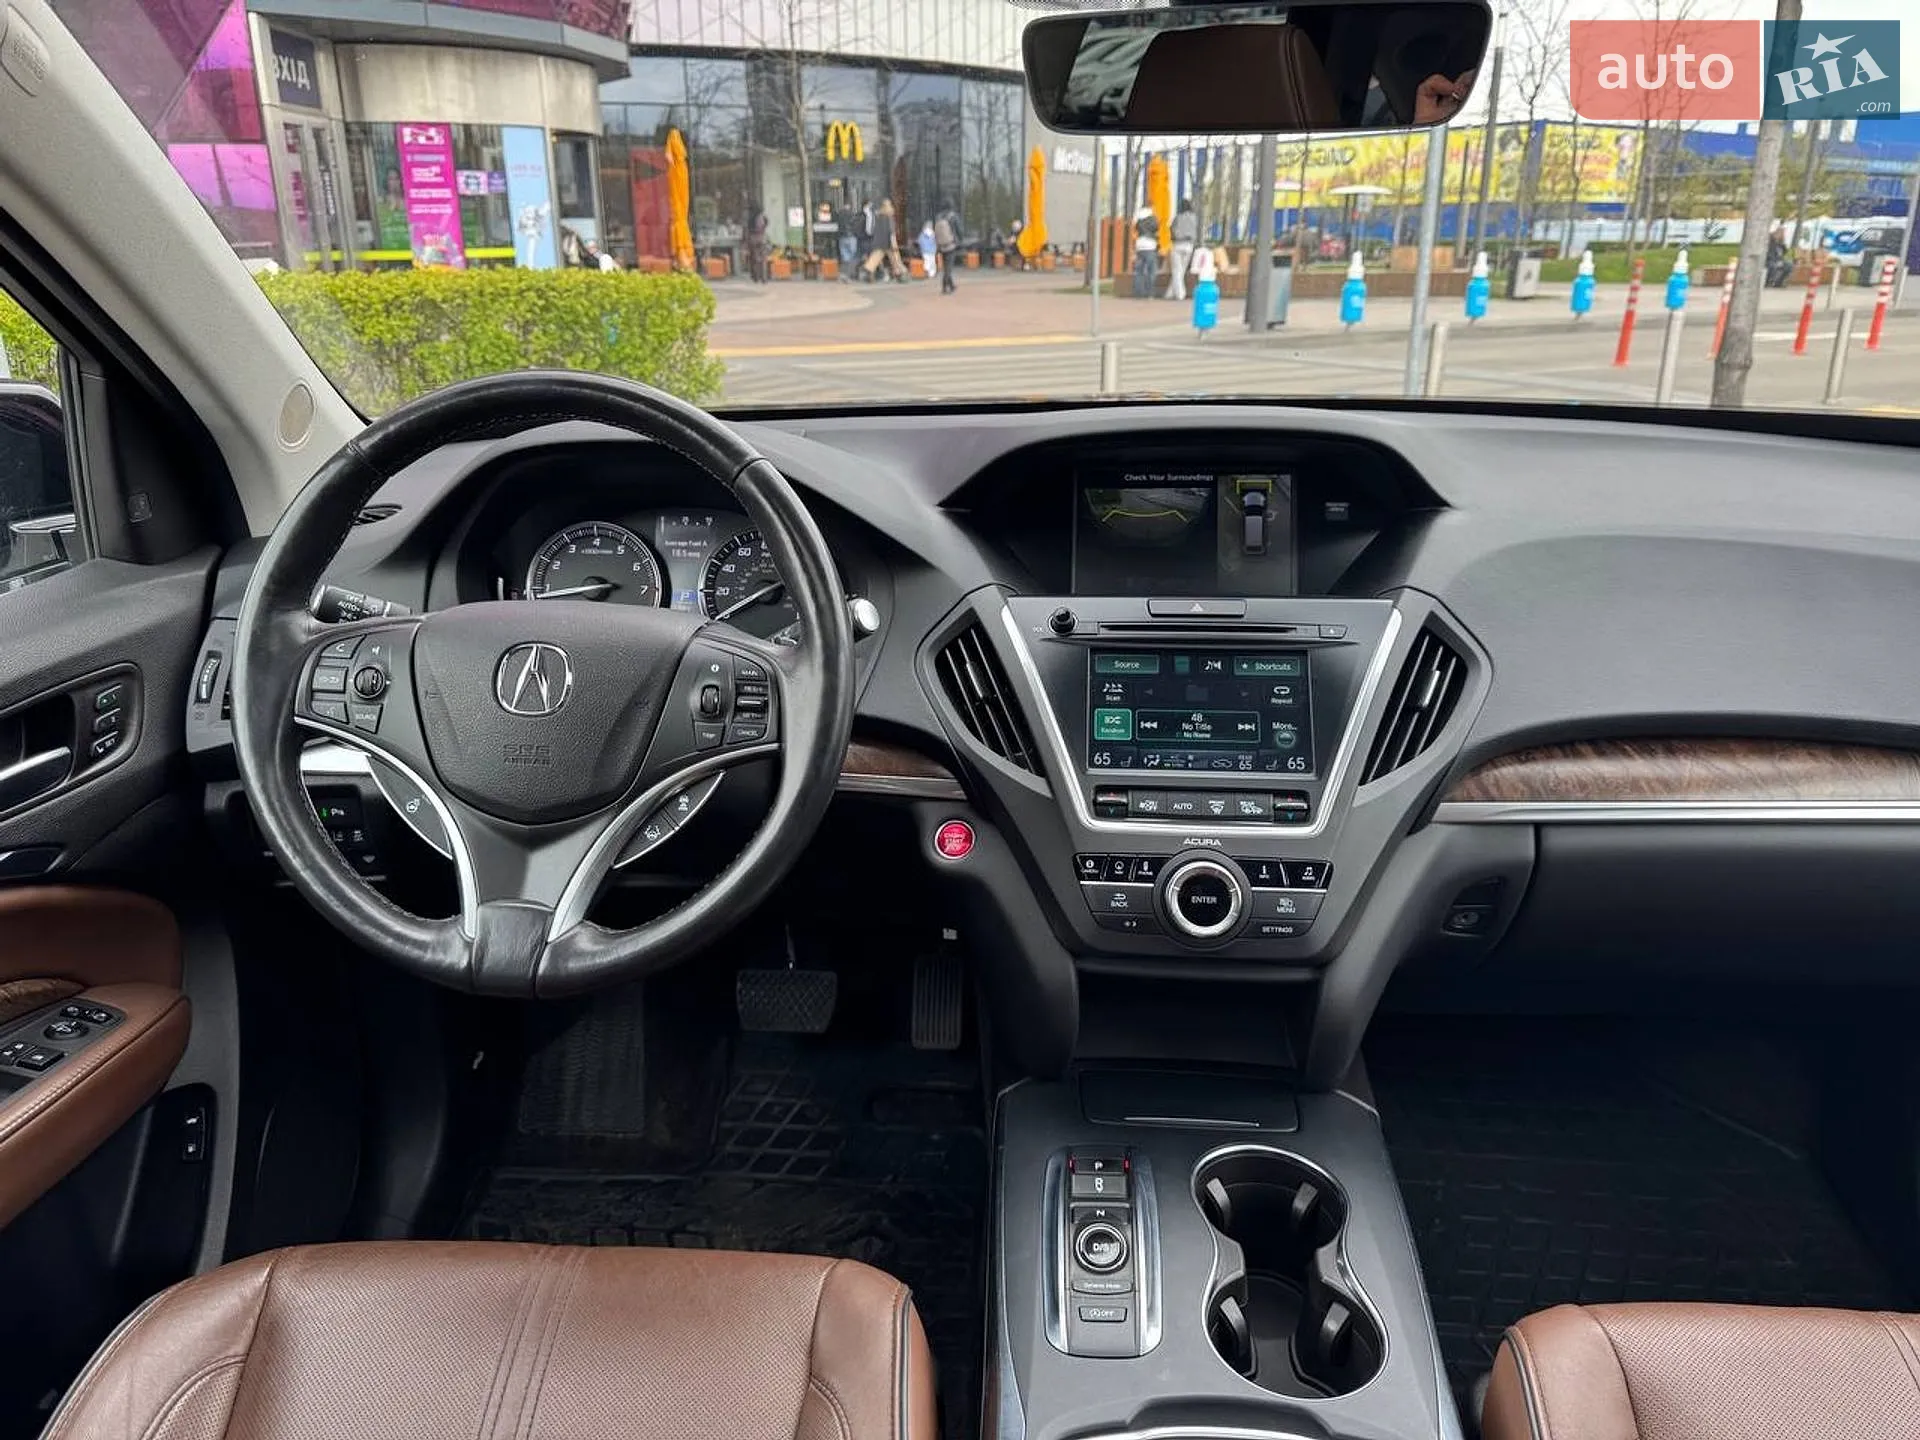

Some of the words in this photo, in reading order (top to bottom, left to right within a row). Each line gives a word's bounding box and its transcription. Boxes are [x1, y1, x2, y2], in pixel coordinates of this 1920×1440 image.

[593, 538, 601, 547] 4
[568, 544, 577, 554] 3
[616, 545, 625, 555] 5
[552, 561, 561, 570] 2
[1114, 660, 1140, 669] Source
[1255, 662, 1292, 671] Shortcuts
[1182, 723, 1194, 731] No
[1093, 752, 1111, 766] 65
[1286, 757, 1305, 770] 65
[1238, 760, 1253, 770] 65
[1183, 838, 1222, 846] ACURA
[1191, 896, 1218, 904] ENTER
[1094, 1161, 1104, 1171] P
[1096, 1209, 1105, 1217] N
